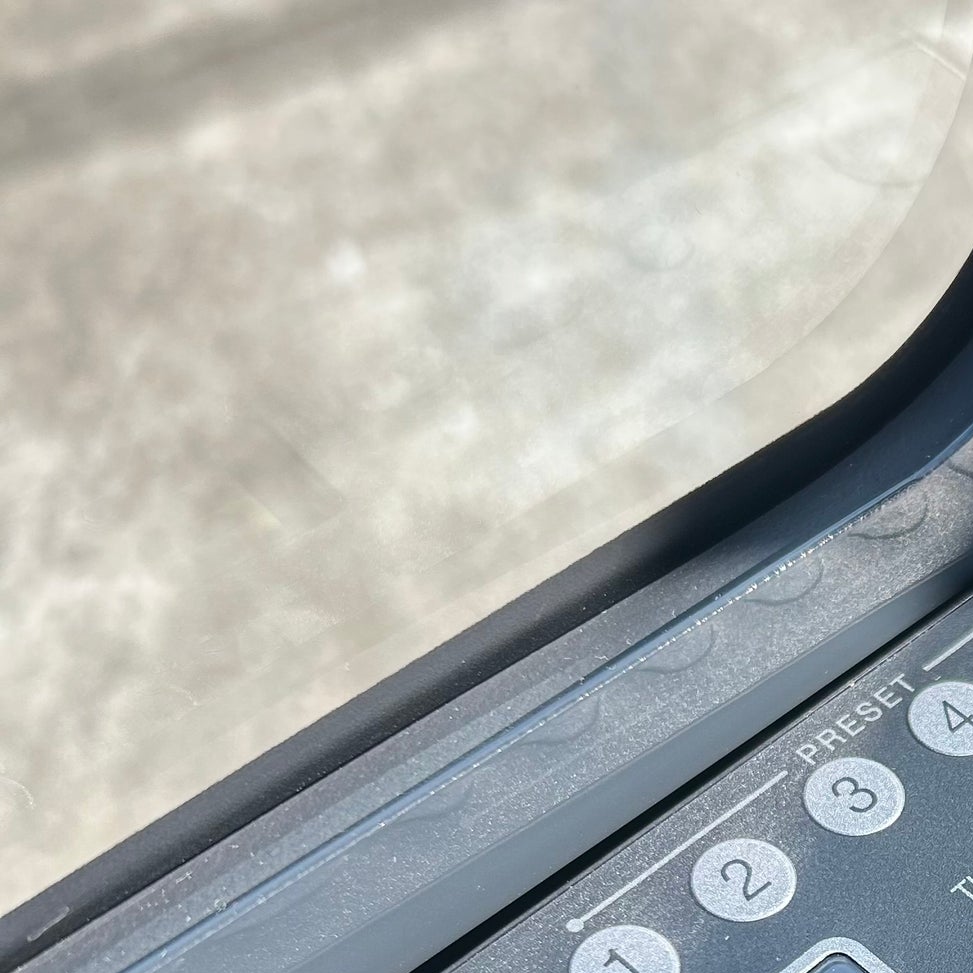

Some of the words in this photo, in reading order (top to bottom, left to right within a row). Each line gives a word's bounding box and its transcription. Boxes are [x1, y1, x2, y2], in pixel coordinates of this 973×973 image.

[796, 673, 917, 765] PRESET
[831, 775, 878, 814] 3
[720, 858, 772, 901] 2
